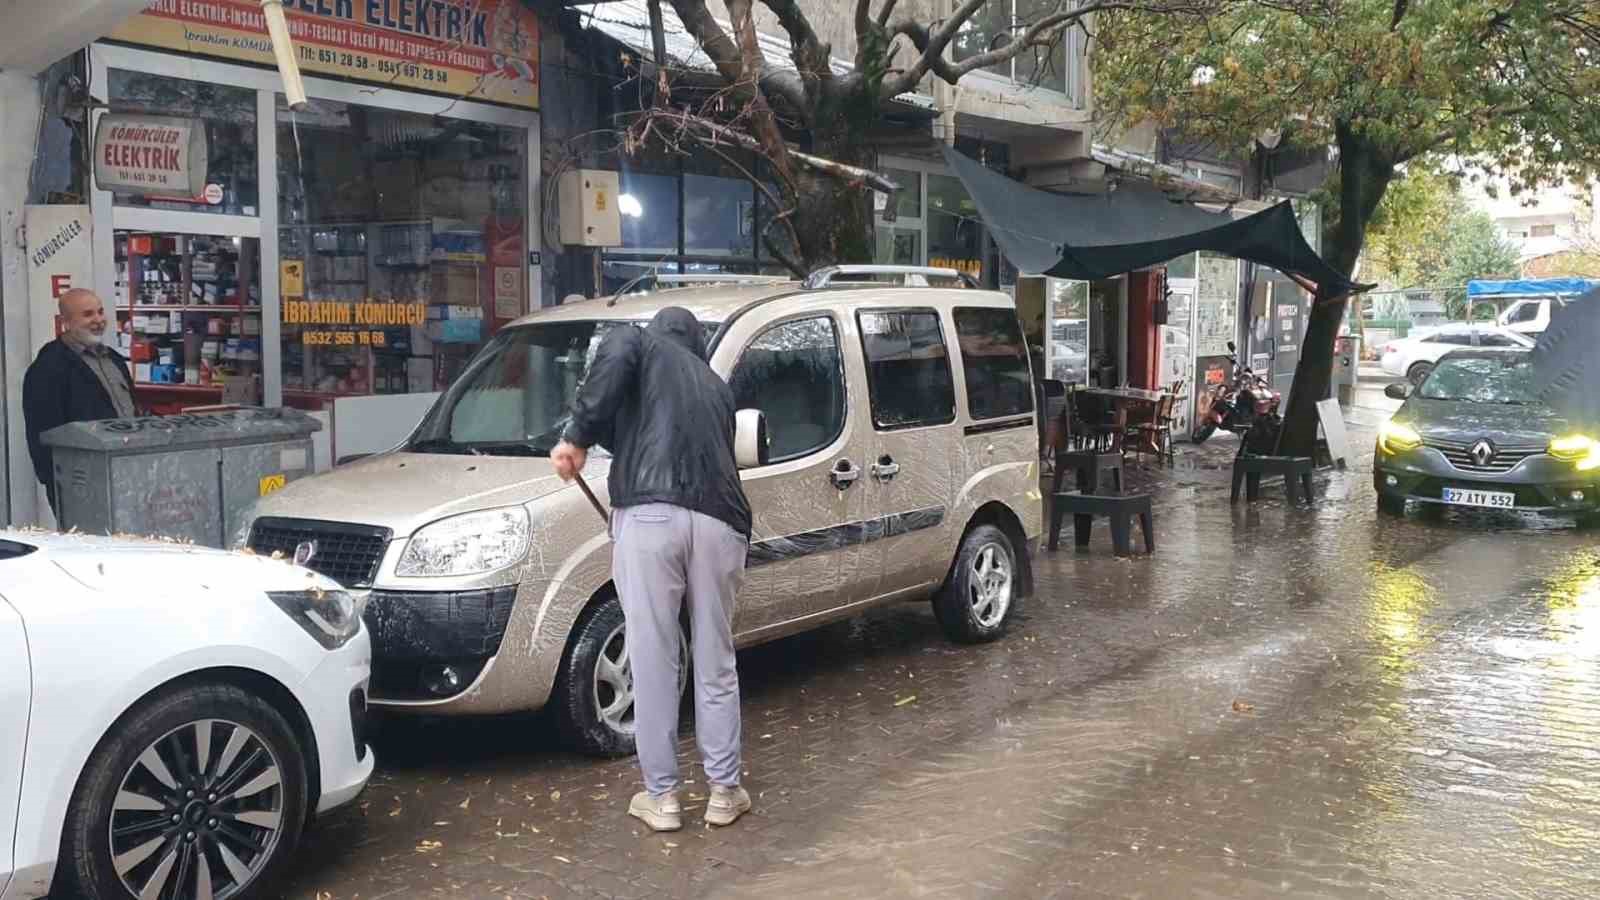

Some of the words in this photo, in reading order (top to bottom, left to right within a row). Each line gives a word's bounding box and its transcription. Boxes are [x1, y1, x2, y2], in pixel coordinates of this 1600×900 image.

[319, 49, 337, 63] 651
[341, 53, 353, 66] 28
[356, 56, 368, 69] 58
[423, 68, 434, 80] 28
[437, 71, 448, 82] 58
[110, 126, 179, 144] KÖMÜRCÜLER
[104, 143, 182, 171] ELEKTRİK
[32, 220, 82, 267] KÖMÜRCÜLER
[284, 298, 350, 323] İBRAHİM
[303, 331, 332, 345] 0532
[1450, 492, 1463, 502] 27
[1491, 495, 1512, 507] 552
